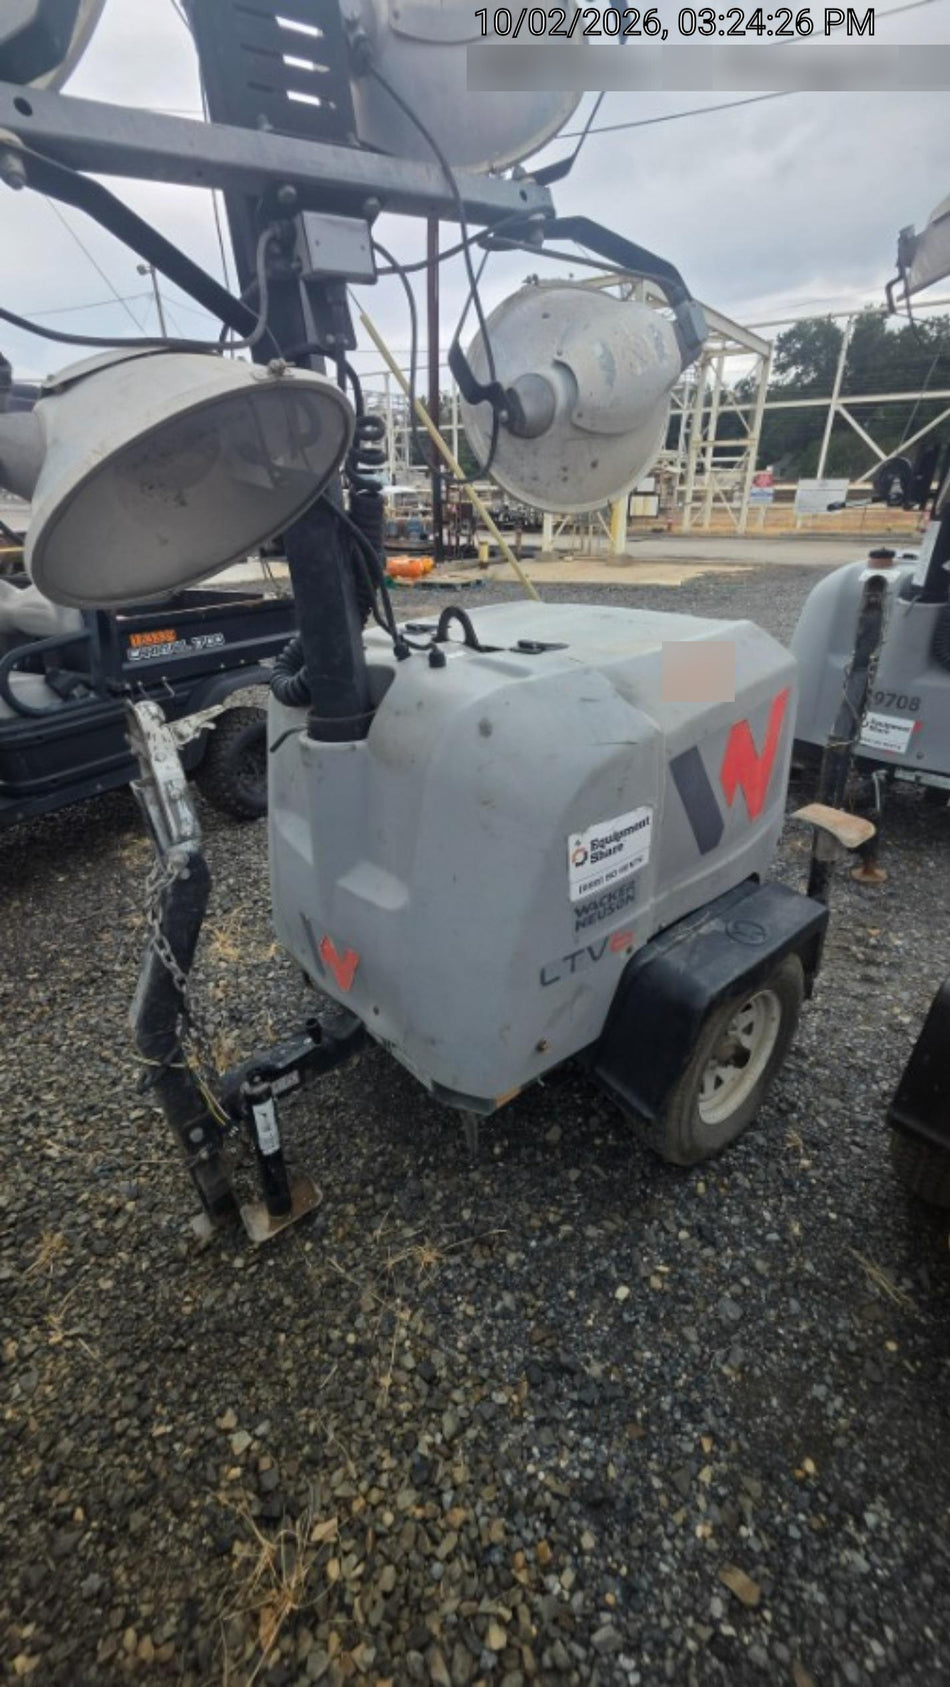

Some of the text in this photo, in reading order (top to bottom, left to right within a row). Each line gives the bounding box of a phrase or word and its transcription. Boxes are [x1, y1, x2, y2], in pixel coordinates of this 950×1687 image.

[590, 815, 650, 851] Equipment
[590, 843, 624, 864] Share
[574, 880, 635, 917] WACKER
[575, 891, 635, 932] NEUSON
